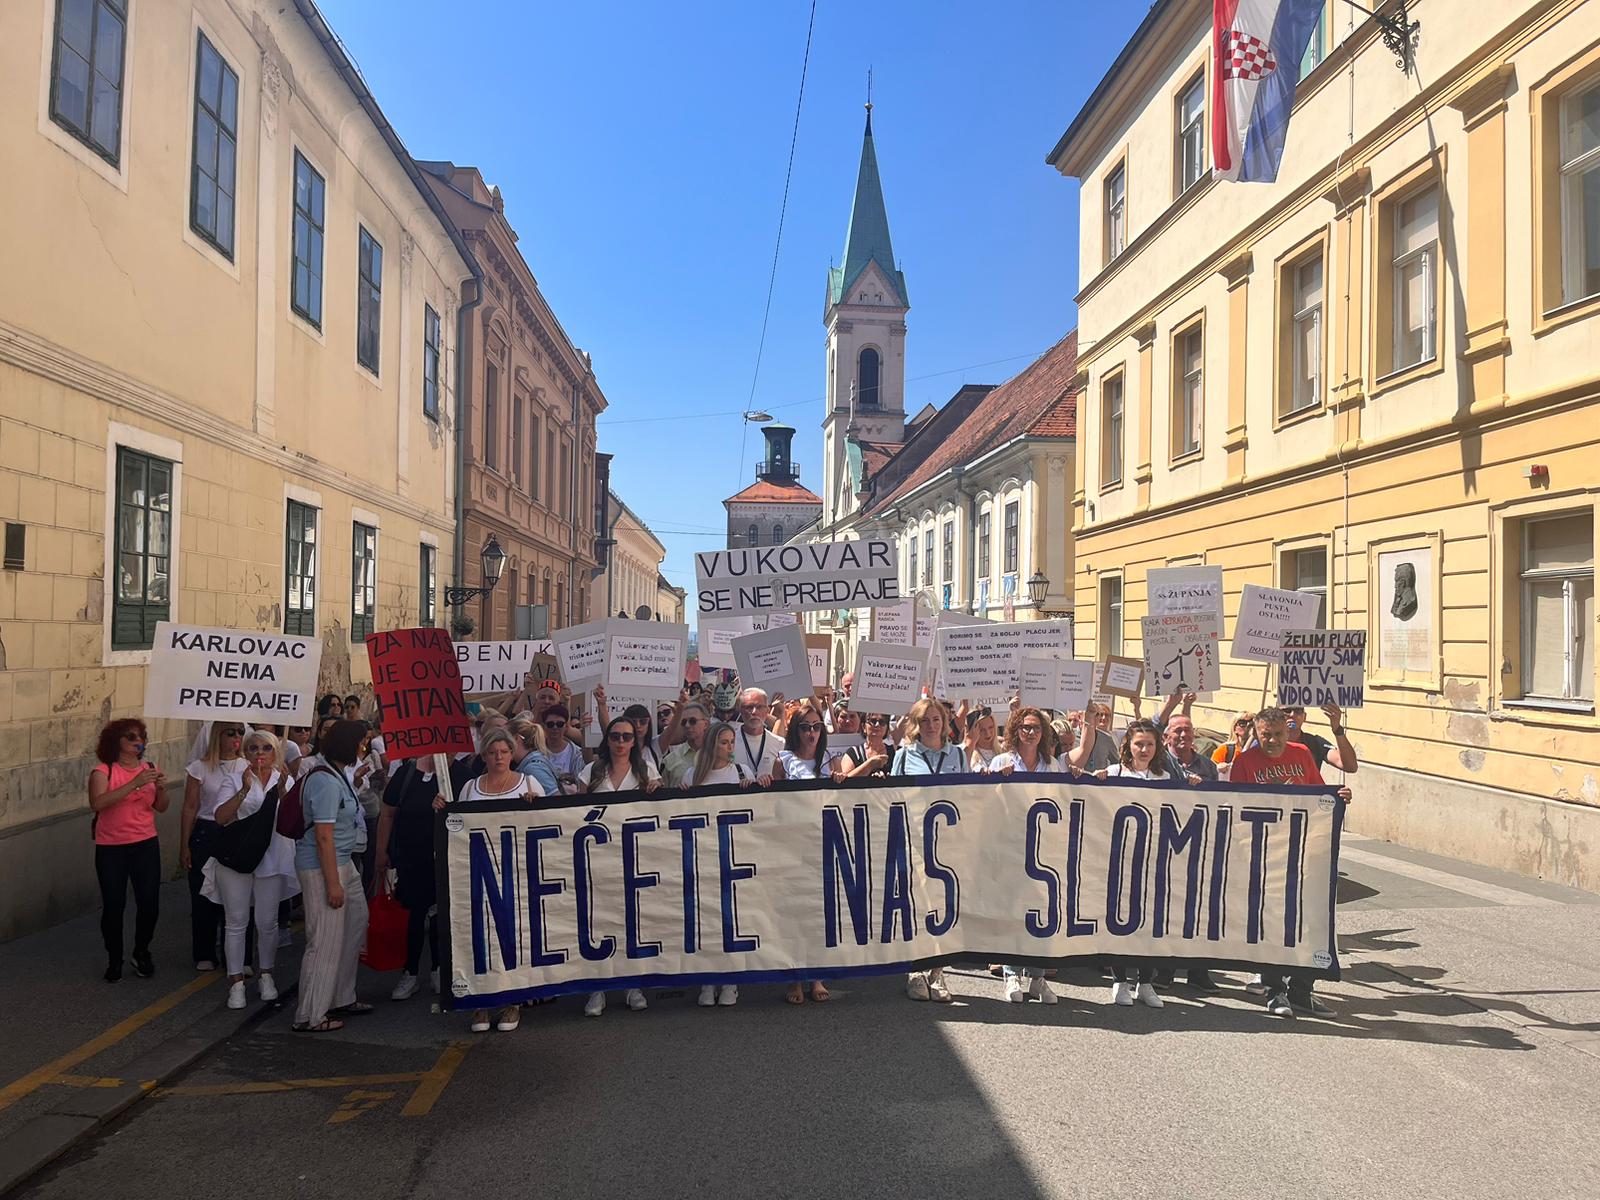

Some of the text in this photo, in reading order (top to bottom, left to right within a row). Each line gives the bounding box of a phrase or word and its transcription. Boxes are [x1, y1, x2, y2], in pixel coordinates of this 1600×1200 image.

[698, 541, 892, 578] VUKOVAR
[698, 577, 899, 613] SE NE PREDAJE
[1168, 588, 1212, 599] ŽUPANJA
[1258, 593, 1303, 607] SLAVONIJA
[1264, 602, 1290, 613] PUSTA
[1161, 616, 1192, 626] NEPRAVDA
[171, 631, 306, 659] KARLOVAC
[366, 631, 402, 658] ZA
[618, 640, 649, 651] Vukovar
[1150, 636, 1177, 646] POSTAJE
[1284, 632, 1326, 648] ŽELIM
[1328, 630, 1367, 648] PLAĆU
[639, 651, 652, 661] kad
[867, 660, 894, 669] Vukovar
[1283, 648, 1363, 666] KAKVU SAM
[206, 660, 276, 681] NEMA
[376, 660, 458, 685] JE OVO
[885, 671, 897, 679] kad
[1280, 665, 1344, 685] NA TV-u
[867, 681, 910, 691] poveća plaća!
[1278, 685, 1313, 705] VIDIO
[1316, 687, 1335, 705] DA
[179, 688, 298, 710] PREDAJE!
[376, 687, 468, 722] HITAN
[383, 726, 471, 750] PREDMET
[1253, 763, 1305, 783] MARLIN
[469, 798, 1309, 975] NEĆETE NAS SLOMITI
